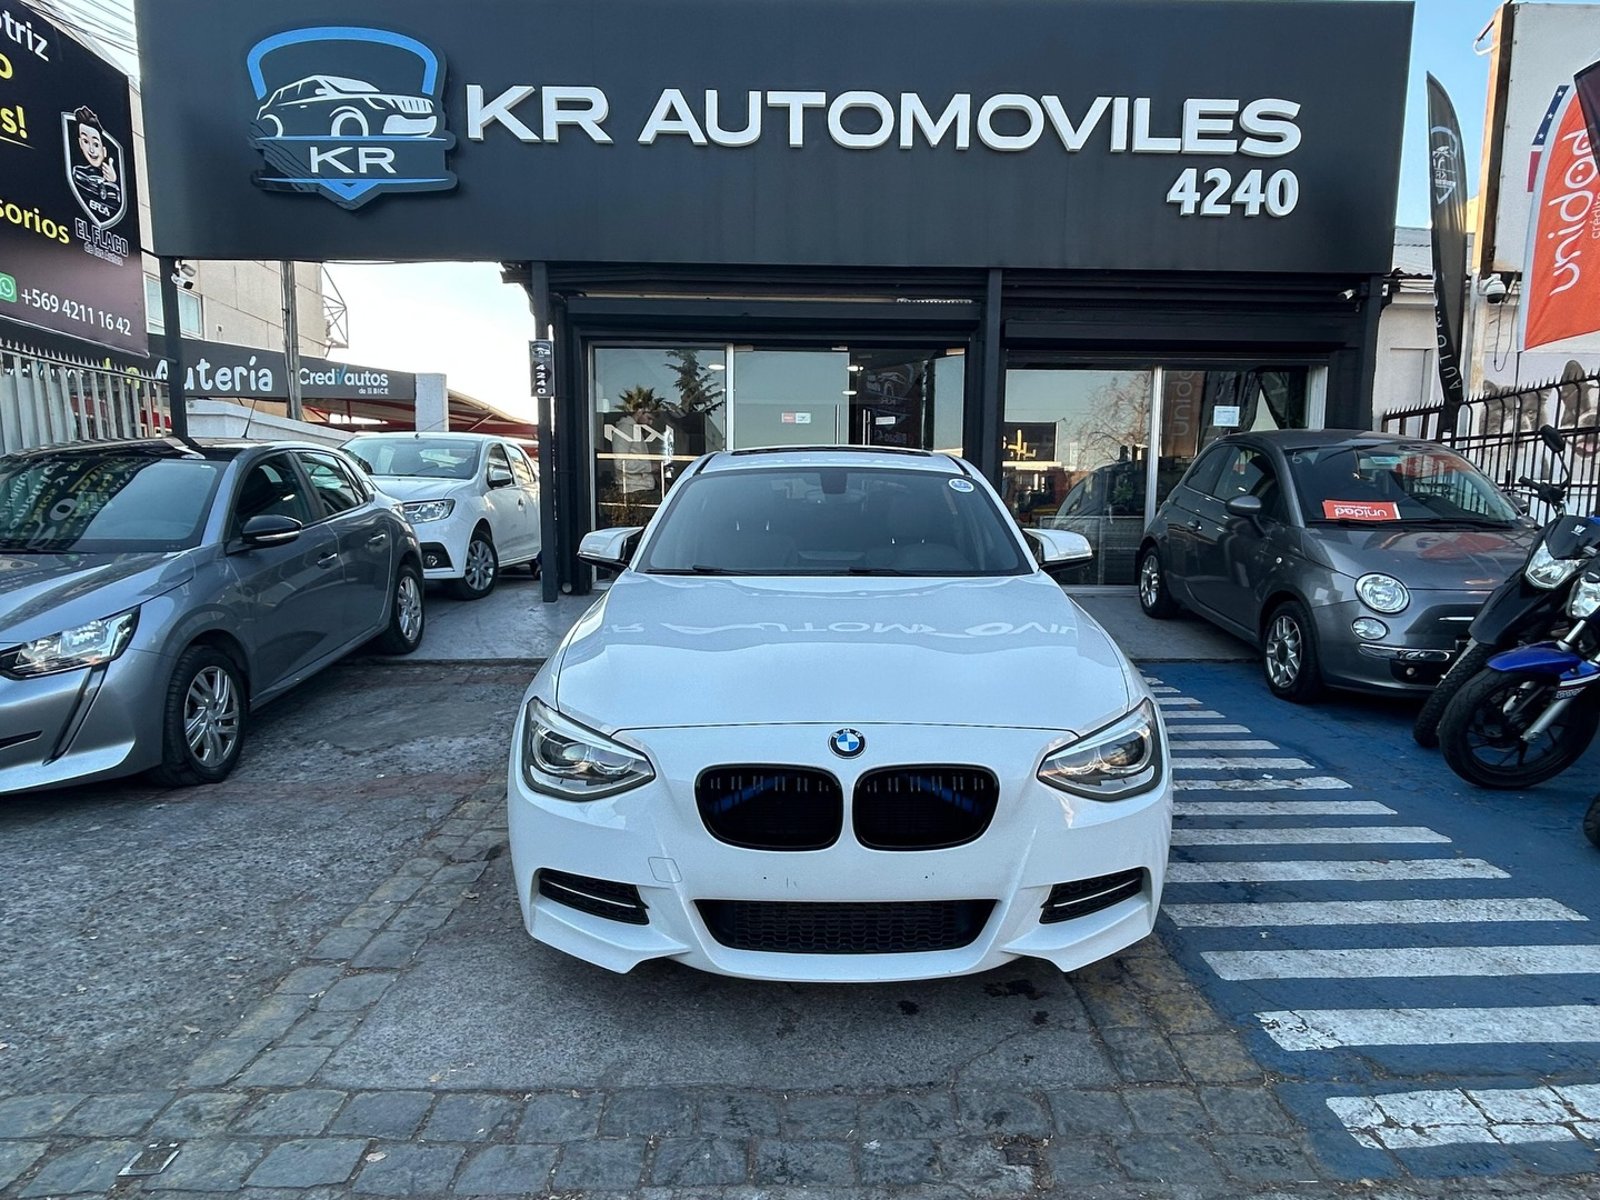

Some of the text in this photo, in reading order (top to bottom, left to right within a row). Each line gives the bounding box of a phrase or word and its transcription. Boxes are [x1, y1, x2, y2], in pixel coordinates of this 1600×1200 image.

[0, 10, 49, 61] triz
[466, 84, 1302, 158] KR AUTOMOVILES
[309, 146, 397, 174] KR
[1166, 167, 1299, 218] 4240
[21, 288, 132, 336] +569 4211 16 42
[535, 364, 546, 394] 4240
